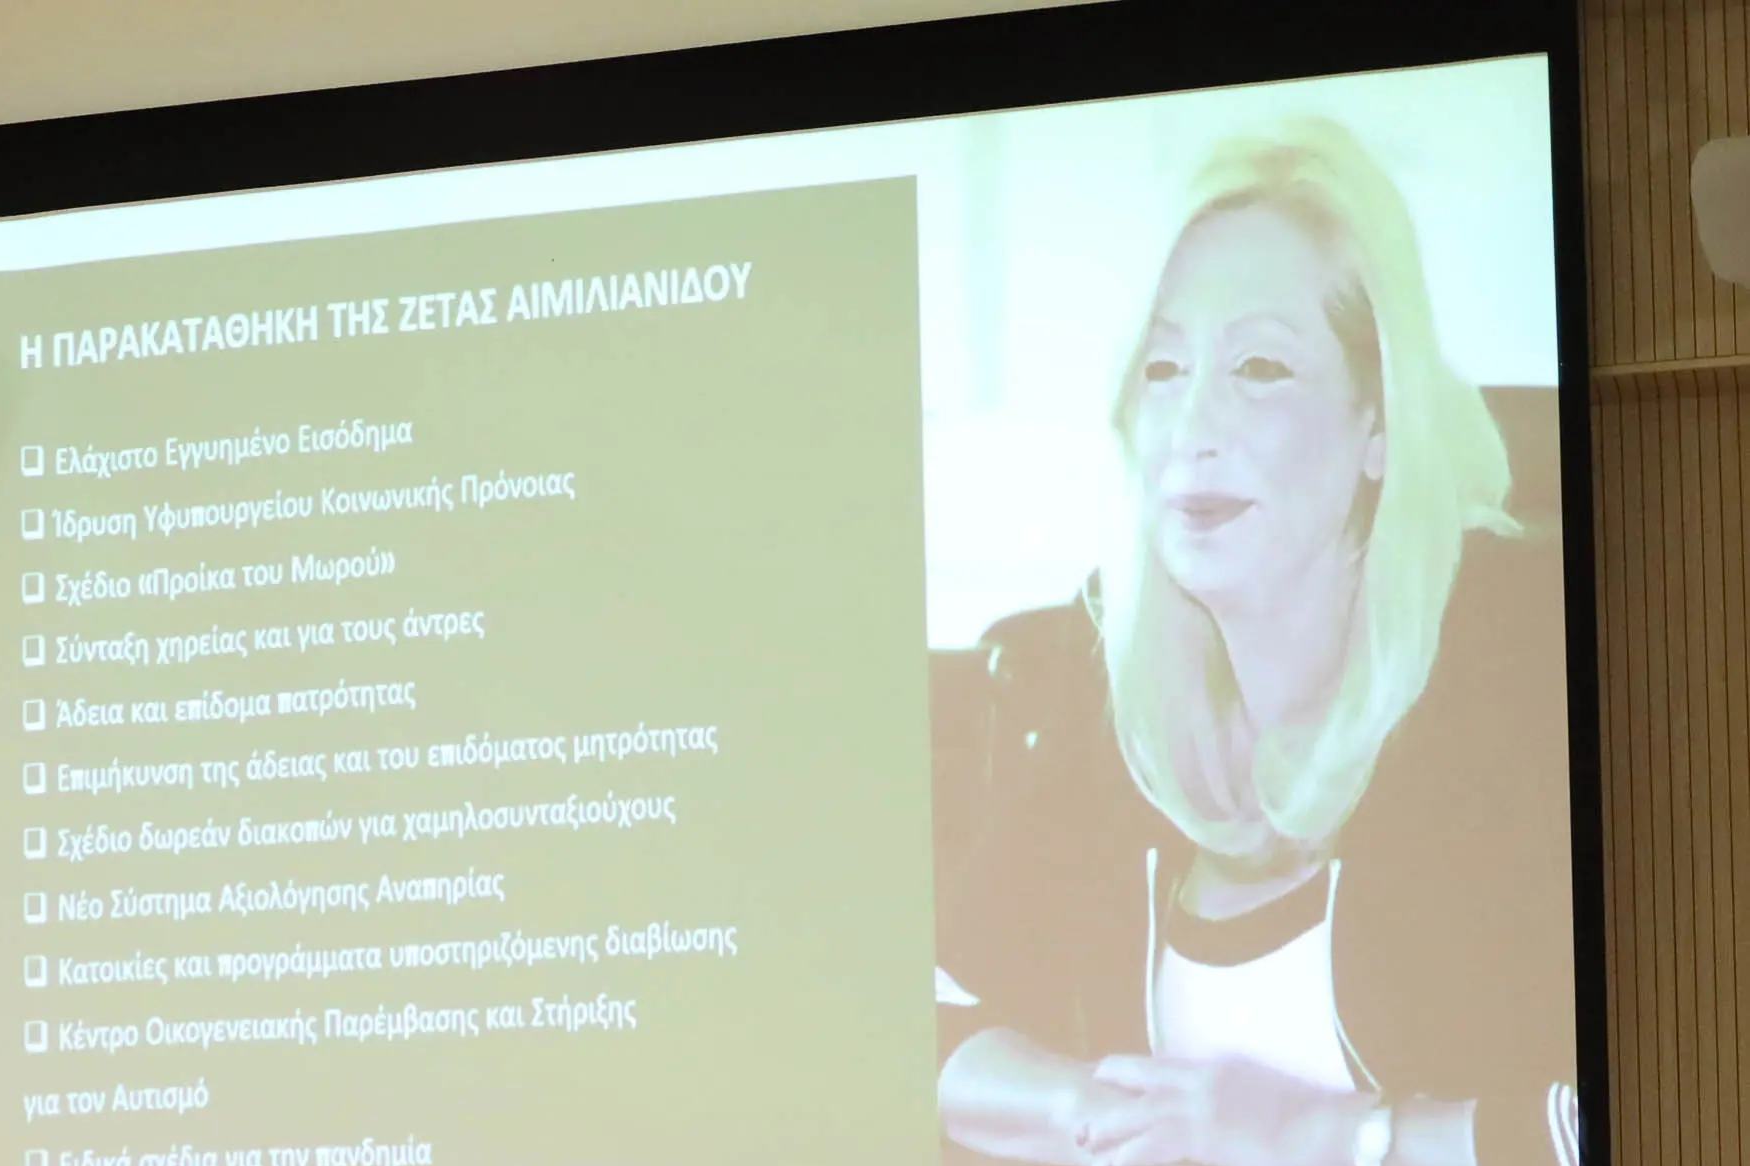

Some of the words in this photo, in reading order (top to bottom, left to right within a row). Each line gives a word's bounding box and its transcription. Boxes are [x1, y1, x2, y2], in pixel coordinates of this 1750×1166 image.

[21, 336, 42, 368] Η
[54, 307, 318, 366] ΠΑΡΑΚΑΤΑΘΗΚΗ
[327, 300, 388, 337] ΤΗΣ
[399, 289, 497, 330] ΖΕΤΑΣ
[507, 263, 752, 321] ΑΙΜΙΛΙΑΝΙΔΟΥ
[56, 446, 158, 477] Ελάχιστο
[166, 428, 290, 469] Εγγυημένο
[299, 420, 412, 451] Εισόδημα
[52, 510, 136, 541] Ίδρυση
[144, 491, 313, 535] Υφυπουργείου
[322, 478, 454, 513] Κοινωνικής
[462, 471, 575, 507] Πρόνοιας
[56, 572, 130, 605] Σχέδιο
[139, 563, 236, 599] «Προίκα
[242, 564, 282, 587] του
[292, 548, 395, 583] Μωρού»
[56, 633, 149, 663] Σύνταξη
[157, 626, 248, 663] χηρείας
[254, 627, 292, 650] και
[297, 624, 334, 651] για
[341, 618, 396, 645] τους
[403, 609, 485, 640] άντρες
[57, 699, 124, 726] Άδεια
[132, 702, 168, 723] και
[174, 692, 272, 722] επίδομα
[277, 680, 416, 715] πατρότητας
[58, 759, 193, 794] Επιμήκυνση
[200, 761, 240, 788] της
[247, 751, 327, 780] άδειας
[334, 751, 371, 773] και
[377, 748, 419, 770] του
[428, 734, 566, 767] επιδόματος
[574, 723, 718, 762] μητρότητας
[58, 826, 132, 861] Σχέδιο
[139, 819, 231, 854] δωρεάν
[238, 812, 352, 845] διακοπών
[359, 816, 397, 843] για
[403, 792, 676, 839] χαμηλοσυνταξιούχους
[59, 892, 103, 919] Νέο
[111, 889, 211, 919] Σύστημα
[219, 881, 370, 915] Αξιολόγησης
[376, 869, 505, 903] Αναπηρίας
[59, 952, 168, 984] Κατοικίες
[175, 956, 212, 978] και
[217, 945, 382, 981] προγράμματα
[390, 931, 599, 968] υποστηριζόμενης
[605, 923, 738, 959] διαβίωσης
[60, 1022, 139, 1052] Κέντρο
[146, 1009, 317, 1048] Οικογενειακής
[325, 1004, 479, 1040] Παρέμβασης
[486, 1006, 525, 1029] και
[531, 994, 637, 1031] Στήριξης
[24, 1094, 61, 1122] για
[66, 1092, 105, 1114] τον
[112, 1079, 209, 1113] Αυτισμό
